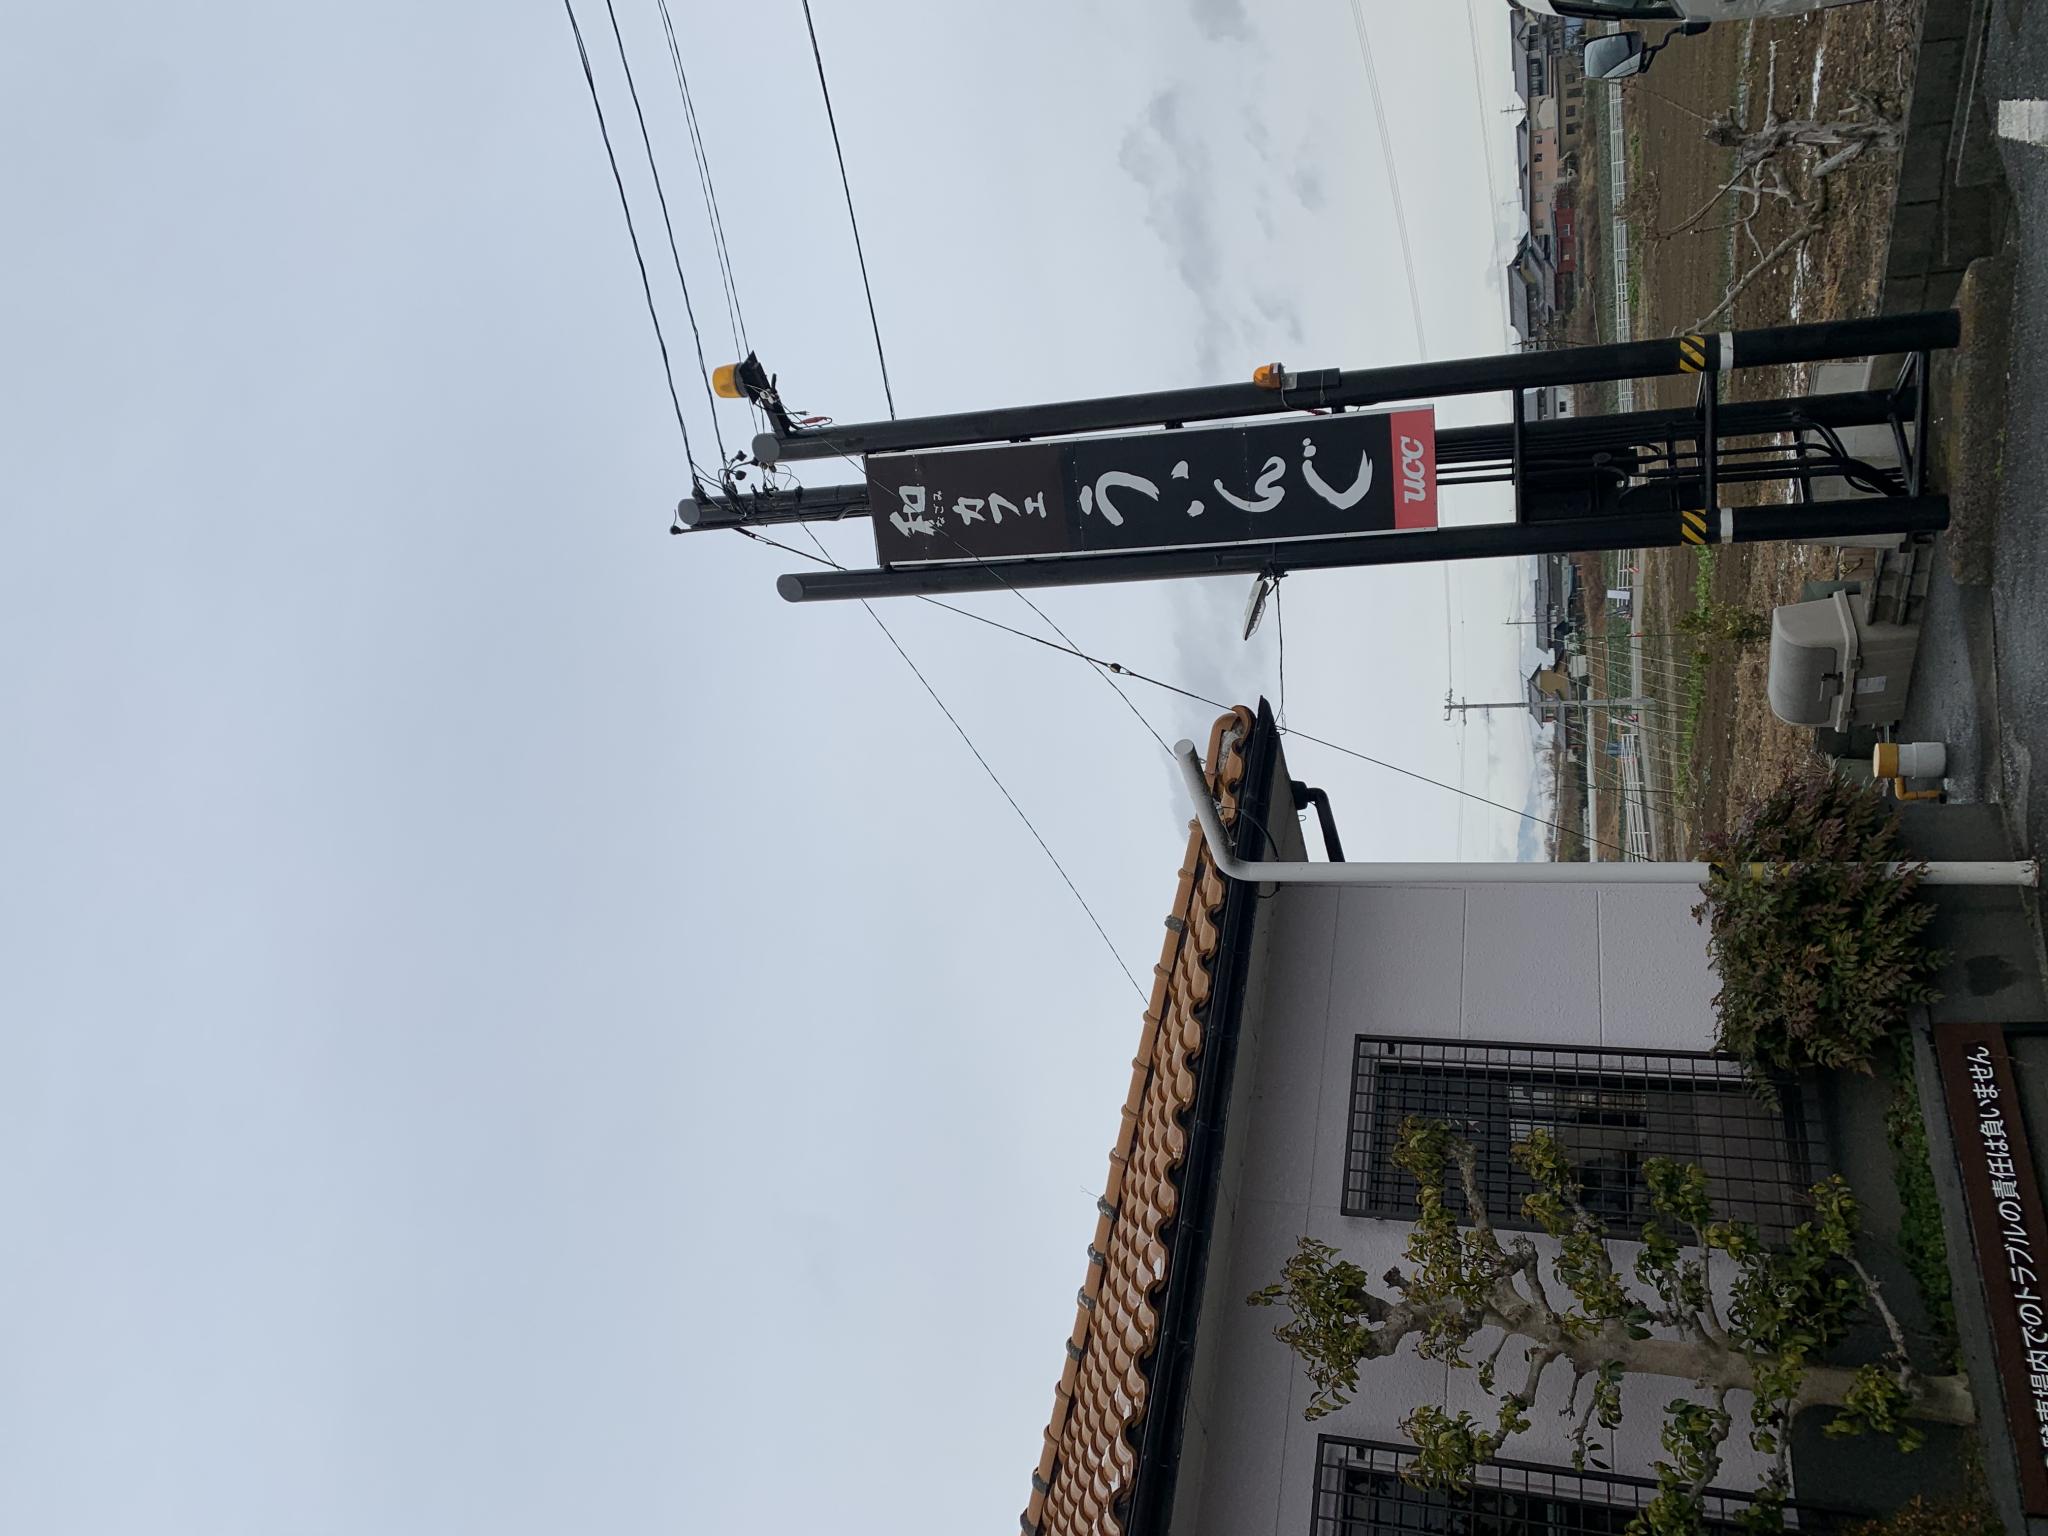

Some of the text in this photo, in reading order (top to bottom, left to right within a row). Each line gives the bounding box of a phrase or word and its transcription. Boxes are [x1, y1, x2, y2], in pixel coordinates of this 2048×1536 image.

[1078, 437, 1373, 527] ういんぐ
[1966, 1046, 2048, 1448] 場内でのトラブルの責任は負いません
